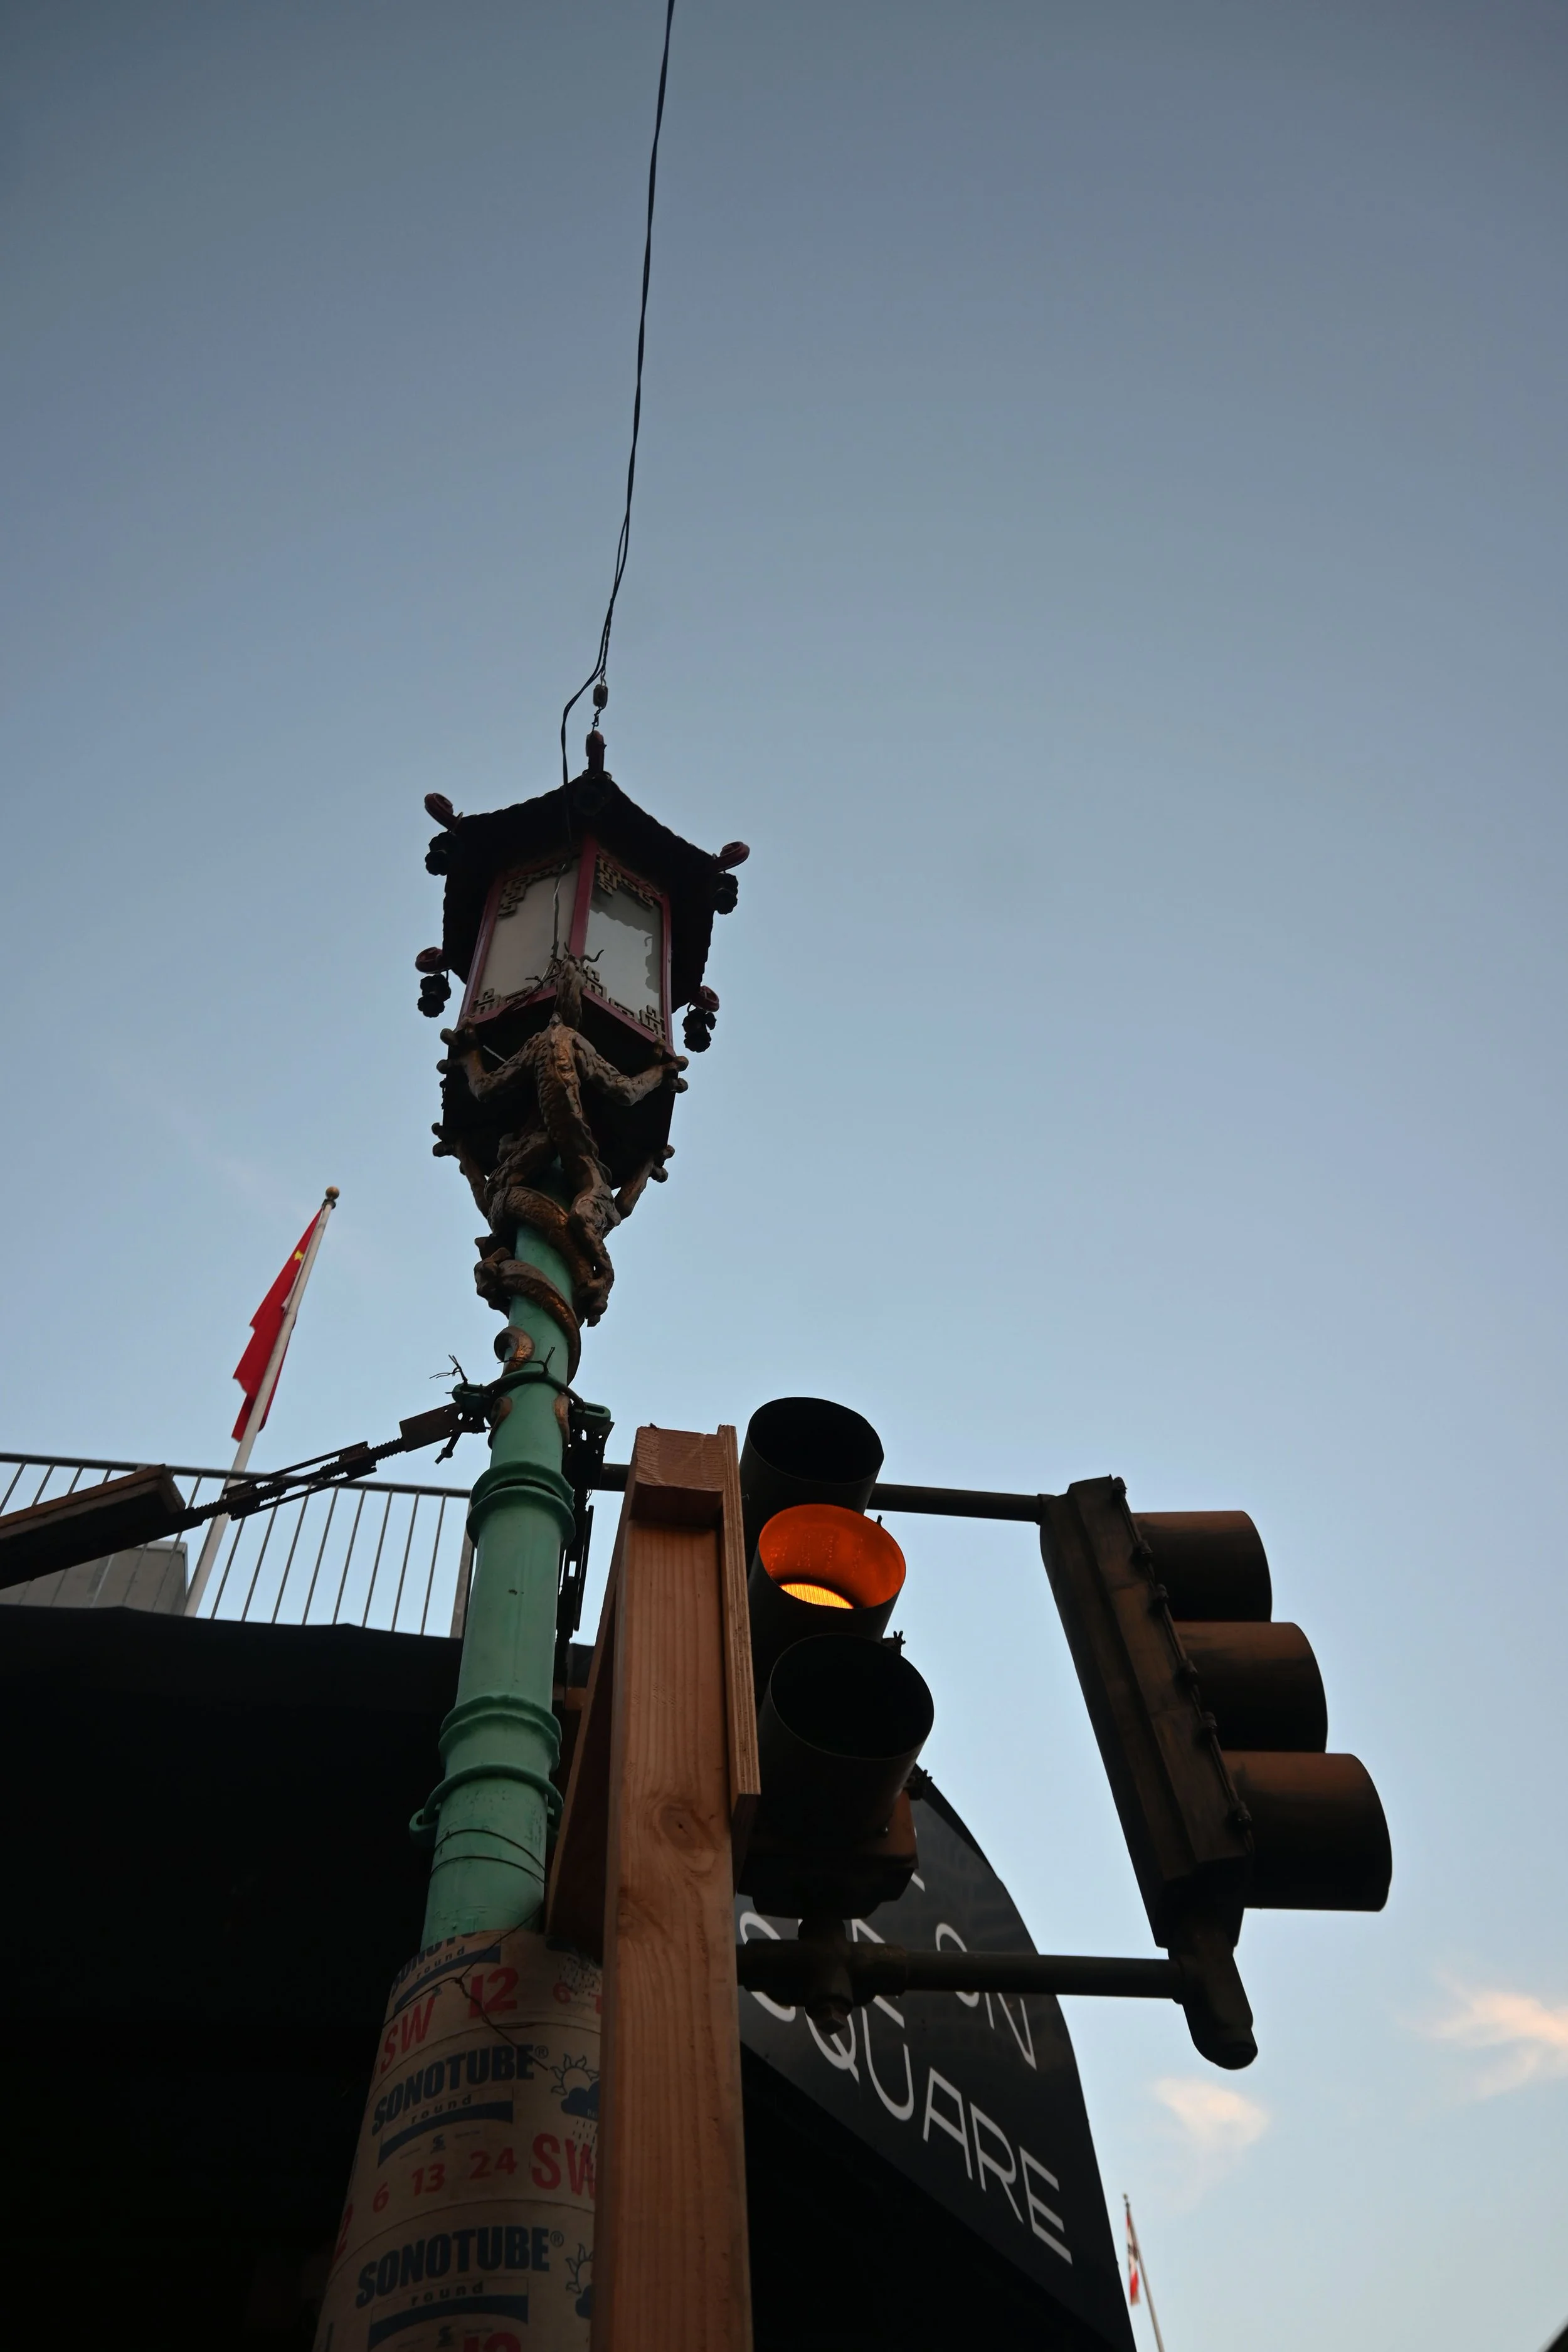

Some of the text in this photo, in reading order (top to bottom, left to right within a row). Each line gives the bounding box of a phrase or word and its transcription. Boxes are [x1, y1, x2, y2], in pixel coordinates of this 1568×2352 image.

[416, 1946, 465, 1980] round
[380, 1995, 435, 2074] SW
[469, 1966, 519, 2019] 12
[411, 2094, 472, 2124] round
[373, 2181, 389, 2213] 6
[411, 2163, 445, 2196] 13
[469, 2147, 517, 2180] 24
[411, 2280, 484, 2306] round
